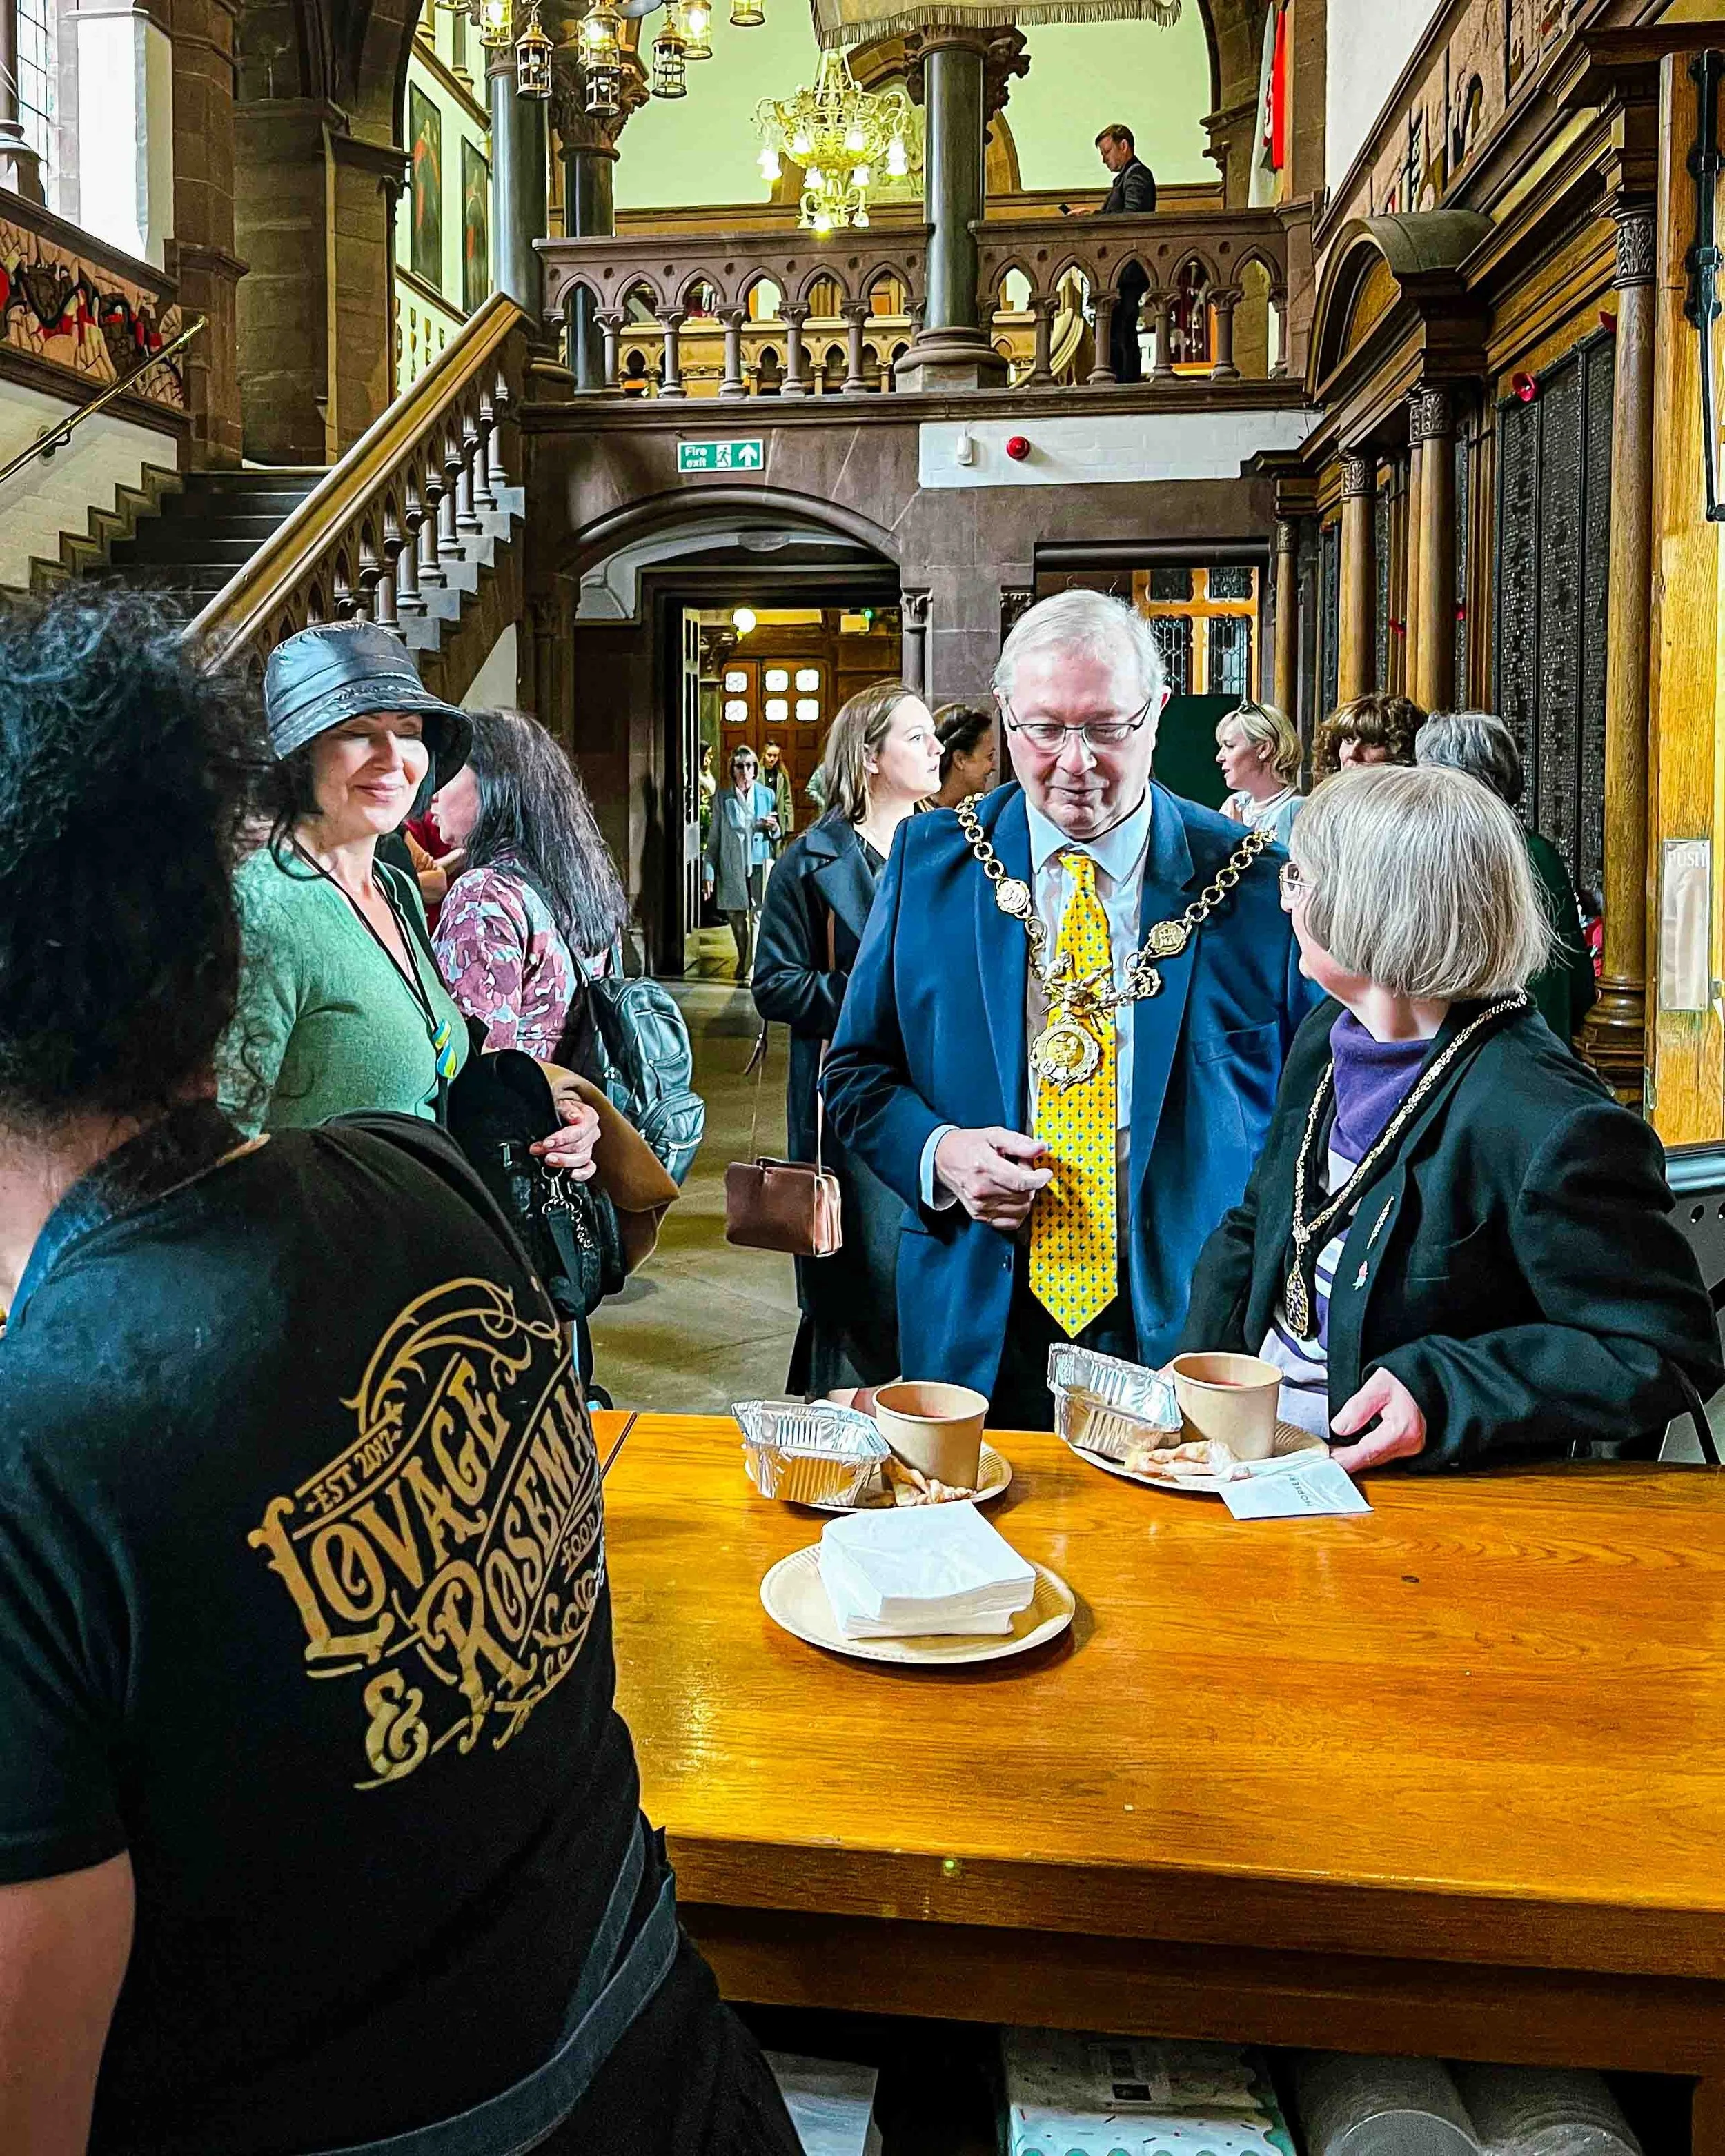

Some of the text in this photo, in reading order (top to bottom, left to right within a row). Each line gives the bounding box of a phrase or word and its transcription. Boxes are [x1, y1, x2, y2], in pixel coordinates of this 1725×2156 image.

[684, 446, 707, 457] Fire
[686, 457, 707, 468] exit
[1667, 851, 1706, 867] PUSH
[313, 1463, 357, 1513] EST
[247, 1356, 511, 1665] LOVAGE
[353, 1668, 429, 1790] &
